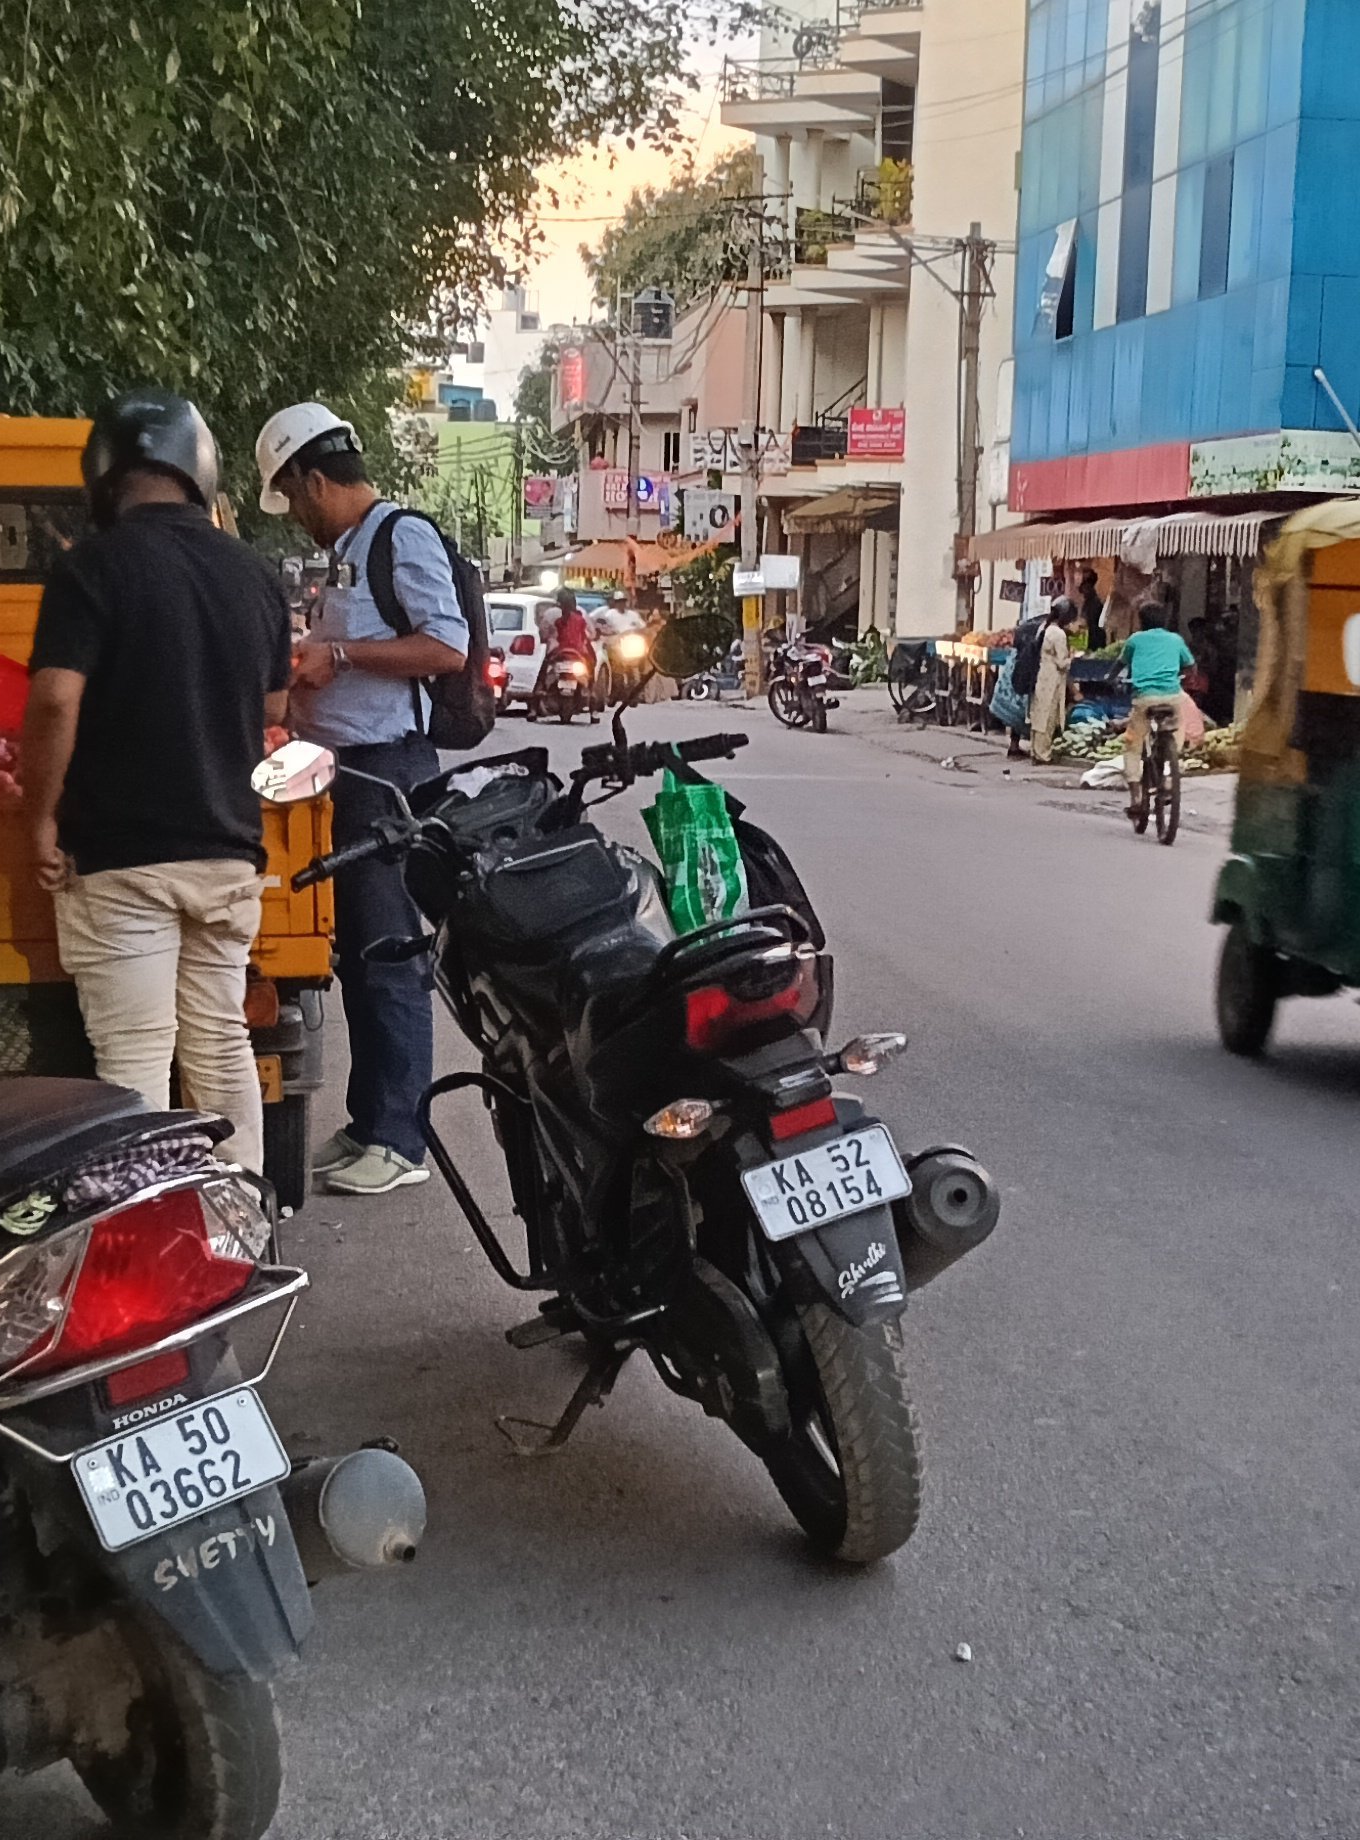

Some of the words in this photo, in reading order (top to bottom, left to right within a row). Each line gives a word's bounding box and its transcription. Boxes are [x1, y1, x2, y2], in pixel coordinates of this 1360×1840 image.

[771, 1158, 814, 1195] KA
[826, 1139, 870, 1173] 52
[111, 1393, 189, 1430] HONDA
[106, 1436, 162, 1488] KA
[175, 1406, 230, 1455] 50
